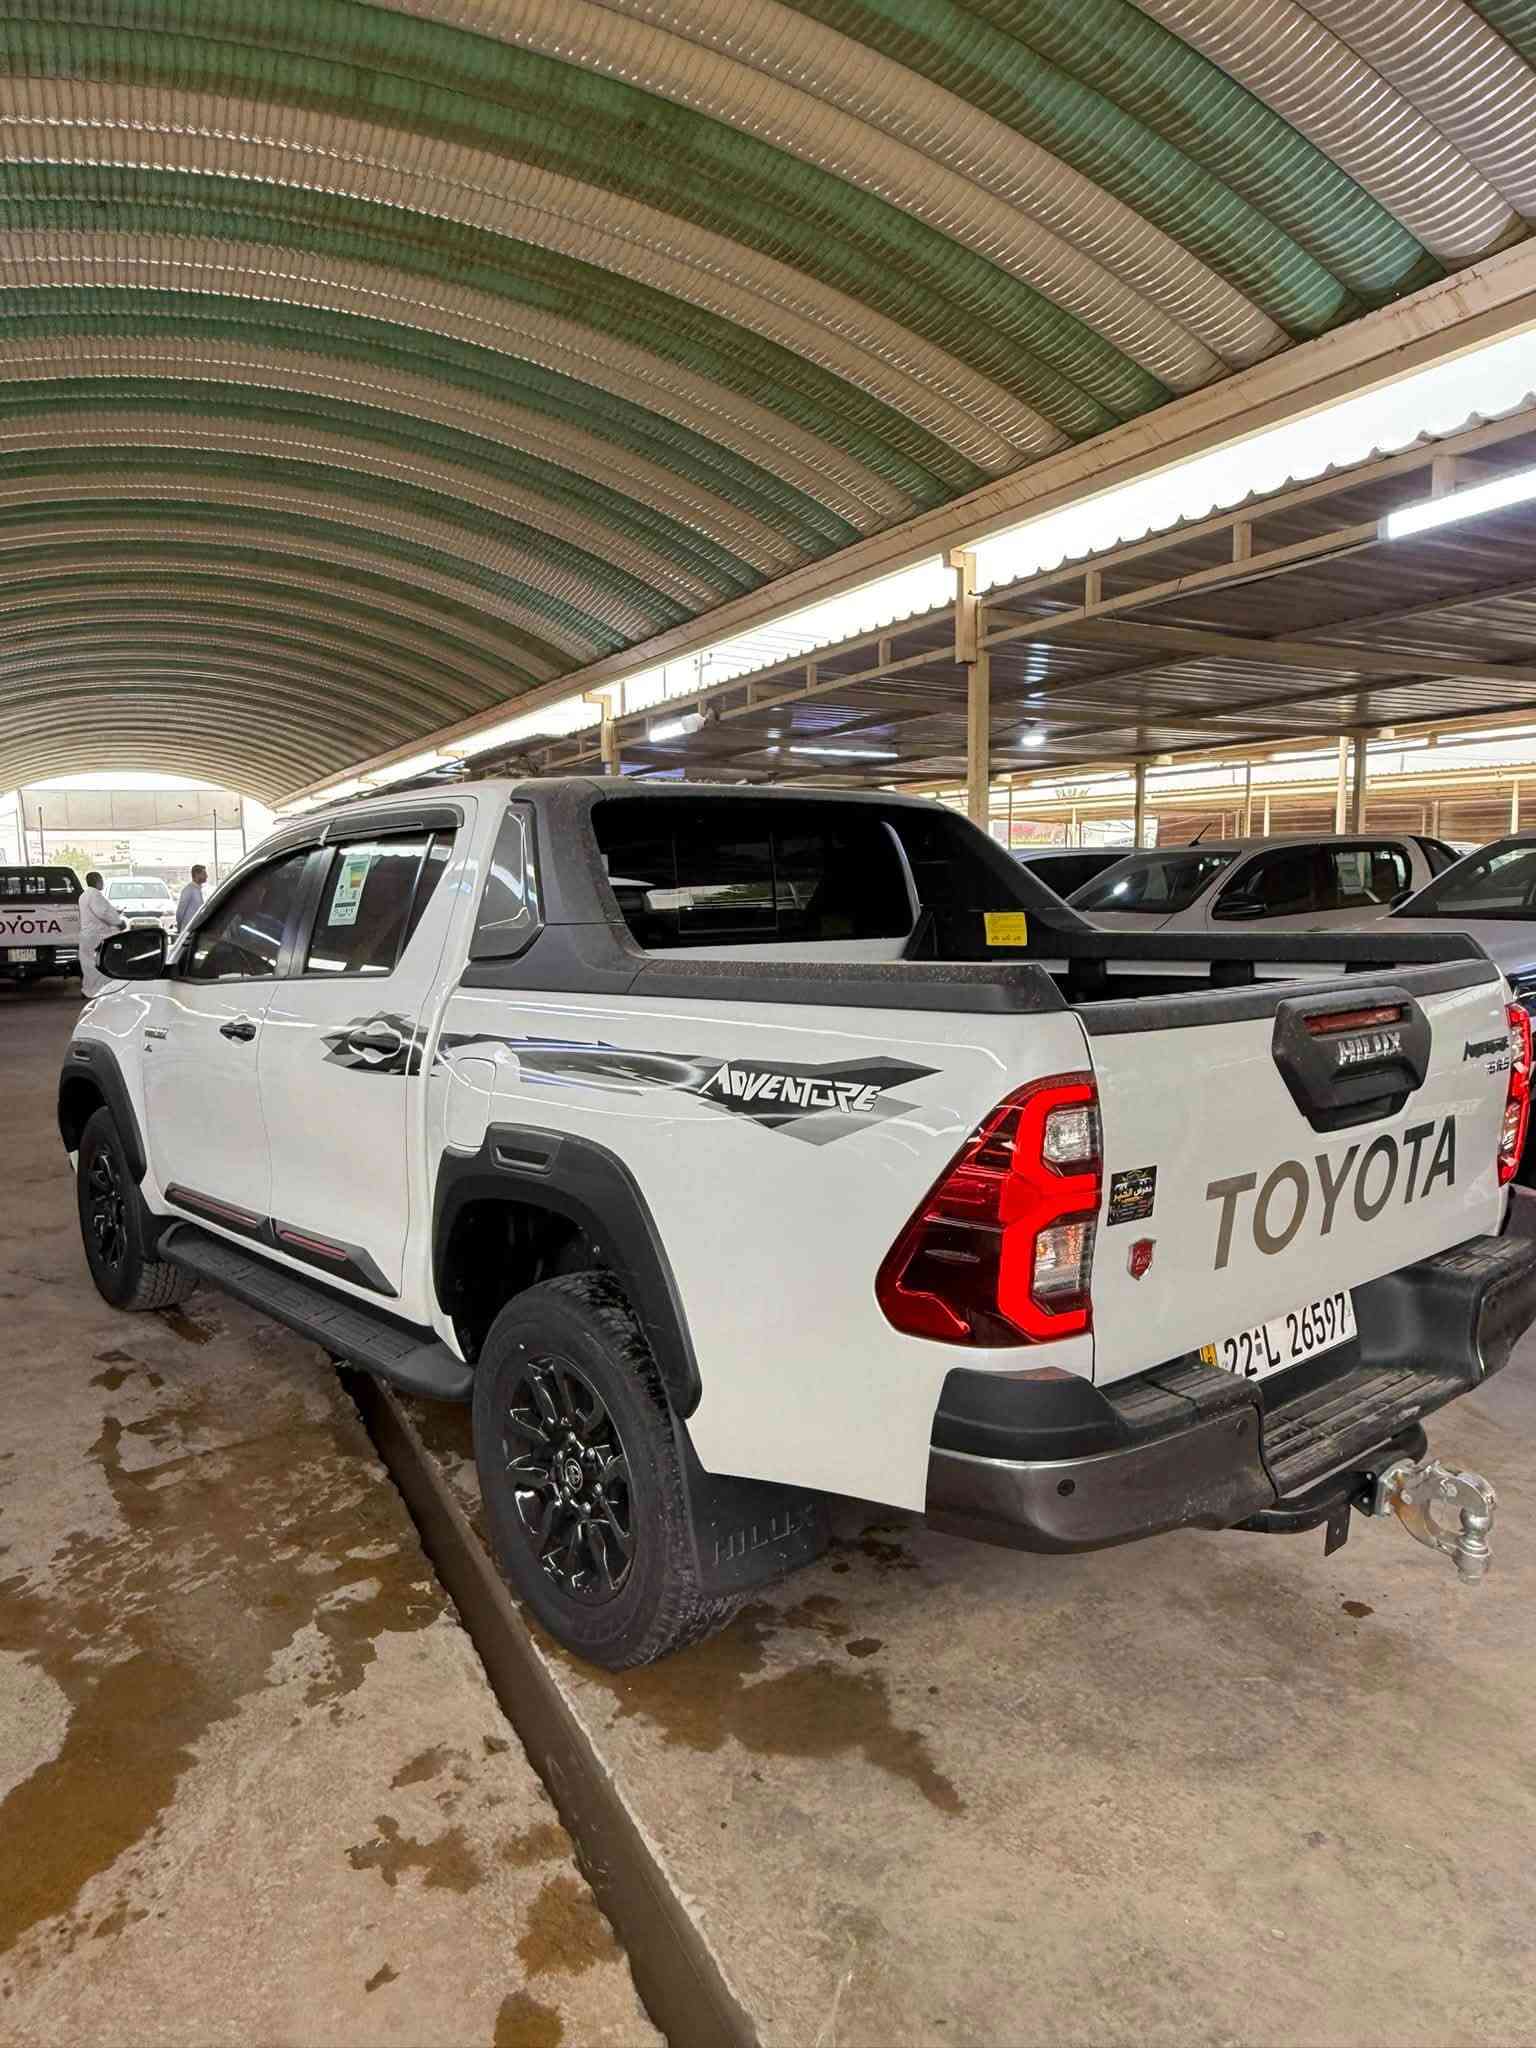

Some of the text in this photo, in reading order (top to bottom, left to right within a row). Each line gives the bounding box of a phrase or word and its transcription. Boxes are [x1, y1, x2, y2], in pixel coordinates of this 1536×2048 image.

[697, 1063, 882, 1113] ADVENTURE
[1206, 1115, 1456, 1270] TOYOTA
[1262, 1324, 1281, 1368] L
[1286, 1292, 1346, 1358] 26597
